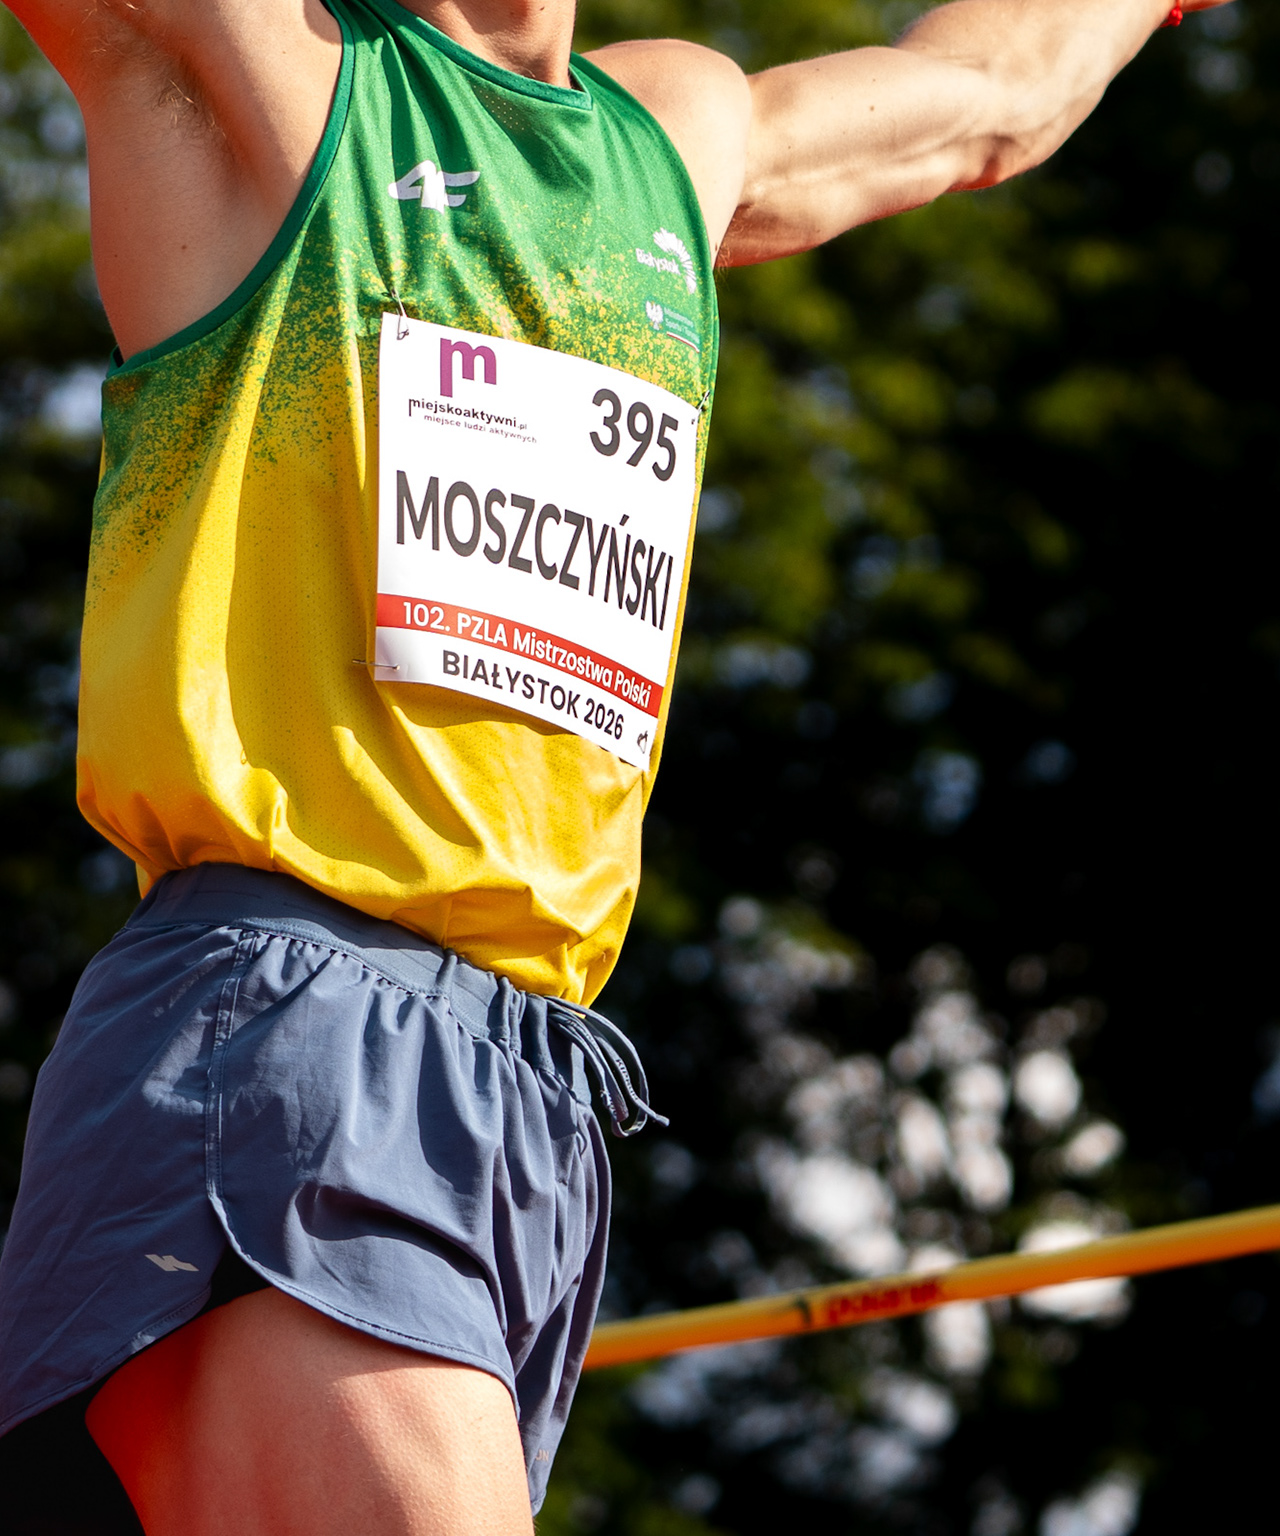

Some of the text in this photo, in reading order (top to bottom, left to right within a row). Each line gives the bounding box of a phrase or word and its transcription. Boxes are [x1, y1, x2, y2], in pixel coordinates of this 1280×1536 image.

[408, 398, 527, 431] miejskoaktywni.pl
[424, 414, 537, 444] miejsce ludzi aktywnych
[589, 388, 679, 481] 395
[396, 469, 673, 631] MOSZCZYŃSKI
[403, 601, 652, 709] 102. PZLA Mistrzostwa Polski
[442, 649, 624, 740] BIAŁYSTOK 2026
